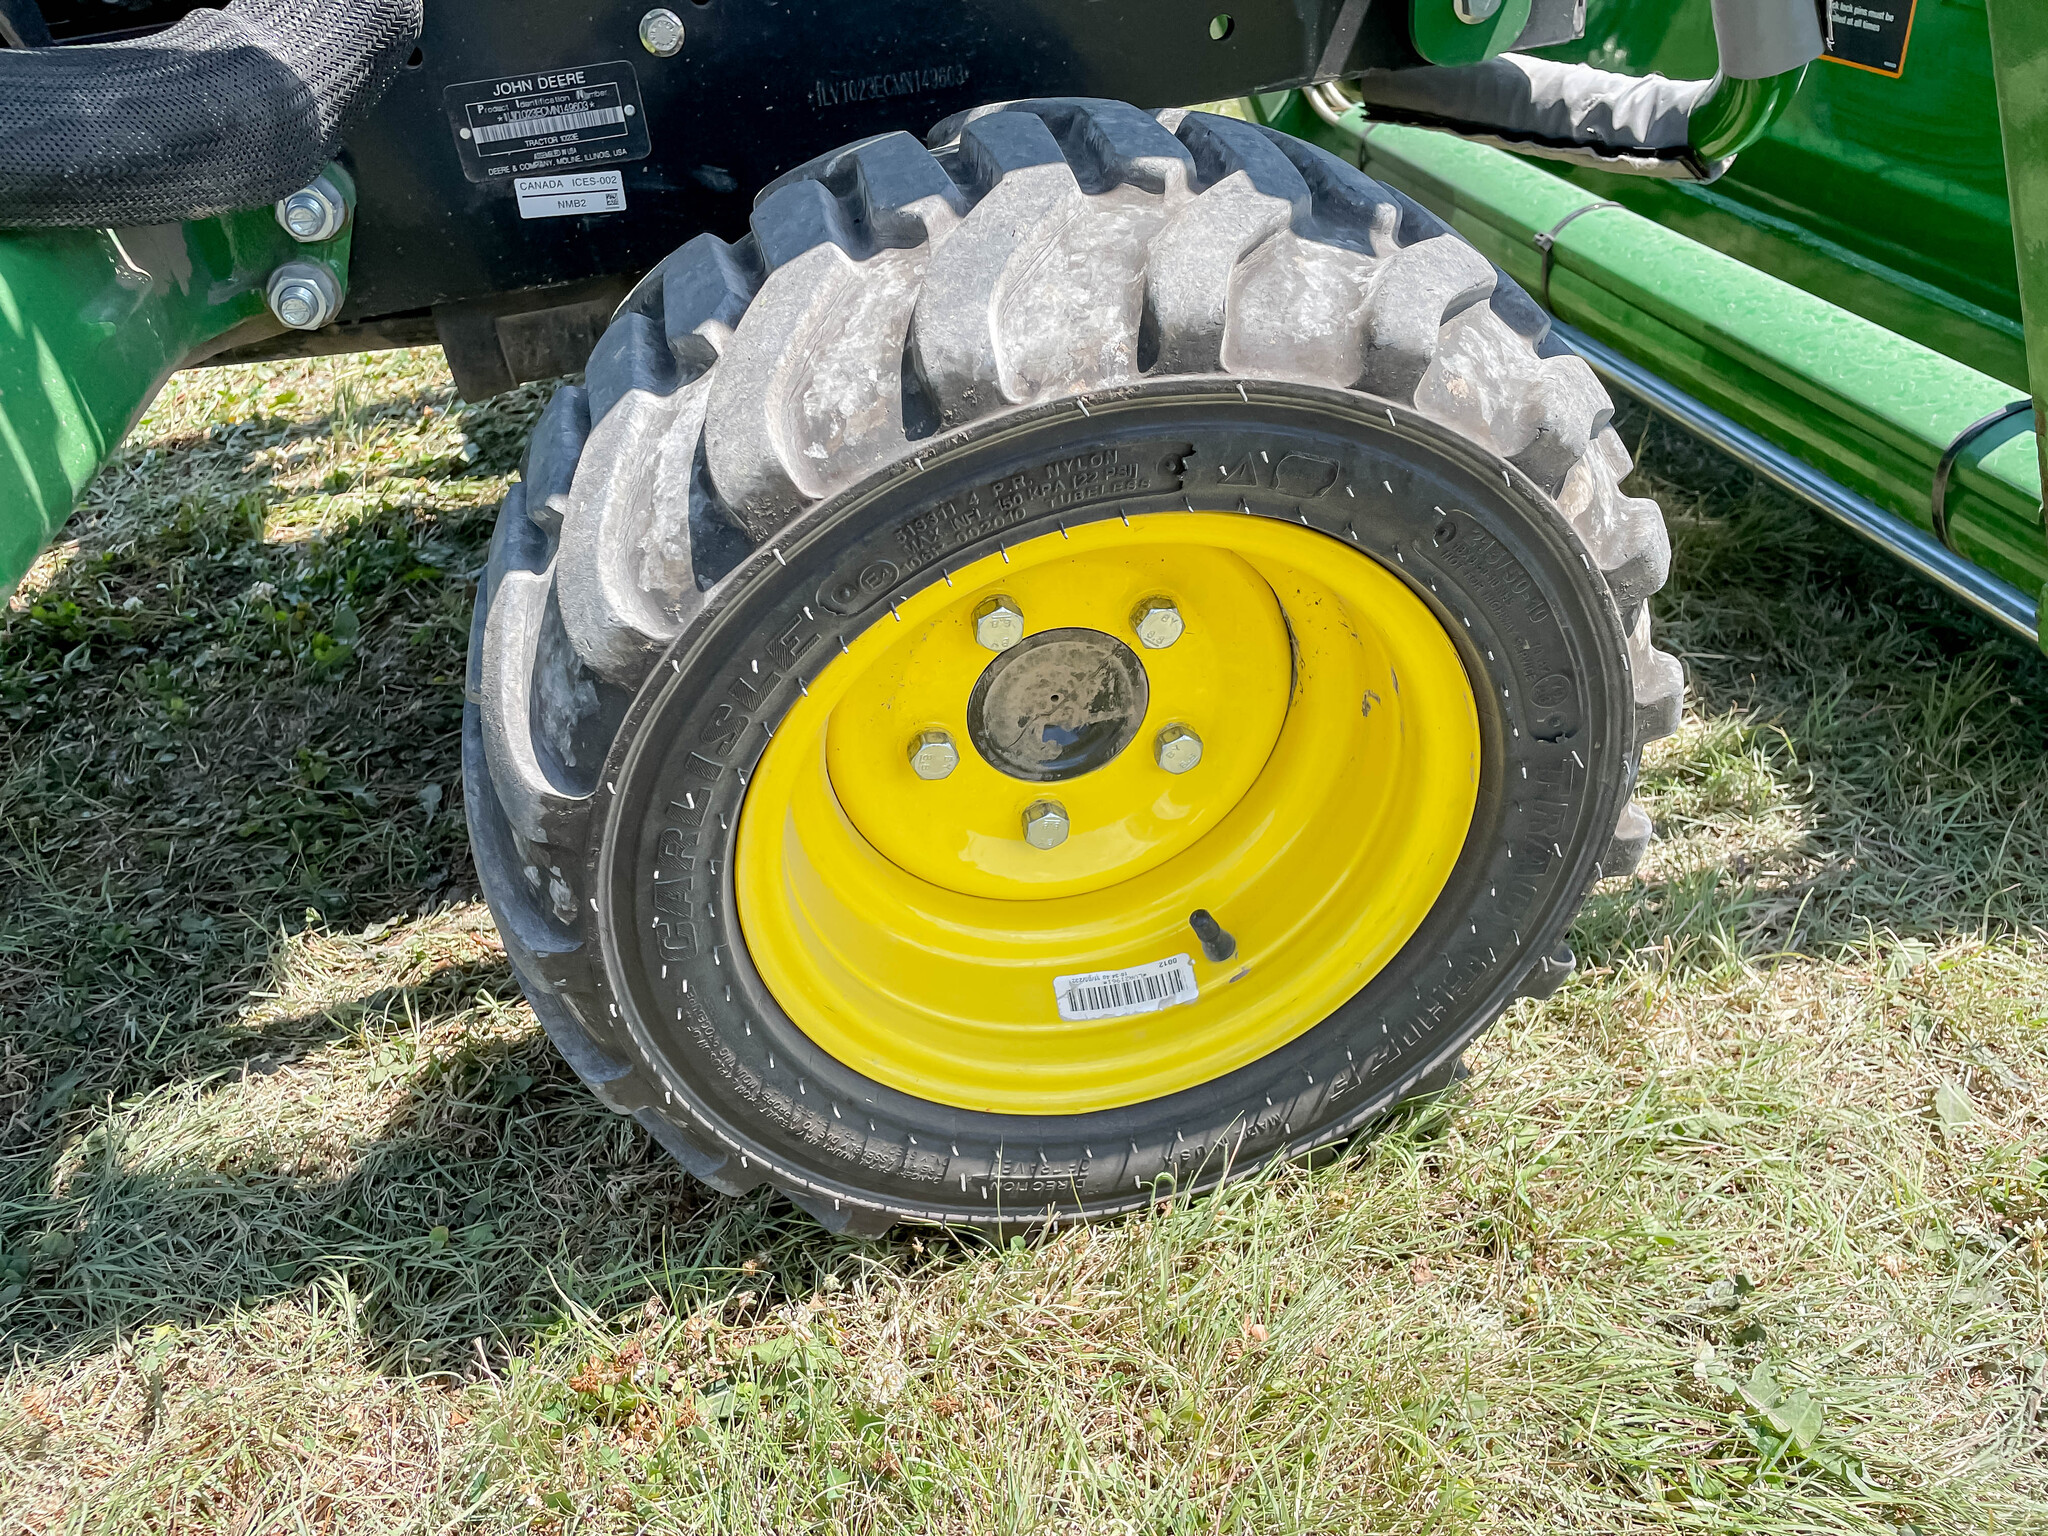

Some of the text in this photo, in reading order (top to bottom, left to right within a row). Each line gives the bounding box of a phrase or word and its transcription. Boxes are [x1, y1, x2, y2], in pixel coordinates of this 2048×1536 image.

[1868, 8, 1885, 20] must
[1885, 11, 1895, 22] be
[493, 71, 586, 97] JOHN DEERE
[477, 88, 608, 115] Product Identification Number
[524, 132, 580, 148] TRACTOR 1023E
[488, 166, 511, 176] DEERE
[613, 148, 628, 157] USA
[519, 175, 618, 191] CANADA ICES-002
[557, 199, 587, 209] NMB2
[969, 491, 980, 506] 4
[1045, 450, 1119, 479] NYLON
[996, 492, 1024, 512] 150
[1028, 479, 1066, 501] KPA
[1044, 479, 1152, 509] TUBELESS
[1464, 571, 1485, 592] FOR
[653, 613, 823, 963] CARLISLE
[1159, 957, 1178, 968] 0012
[818, 1132, 841, 1144] DUE
[988, 1177, 1086, 1191] DRECTION
